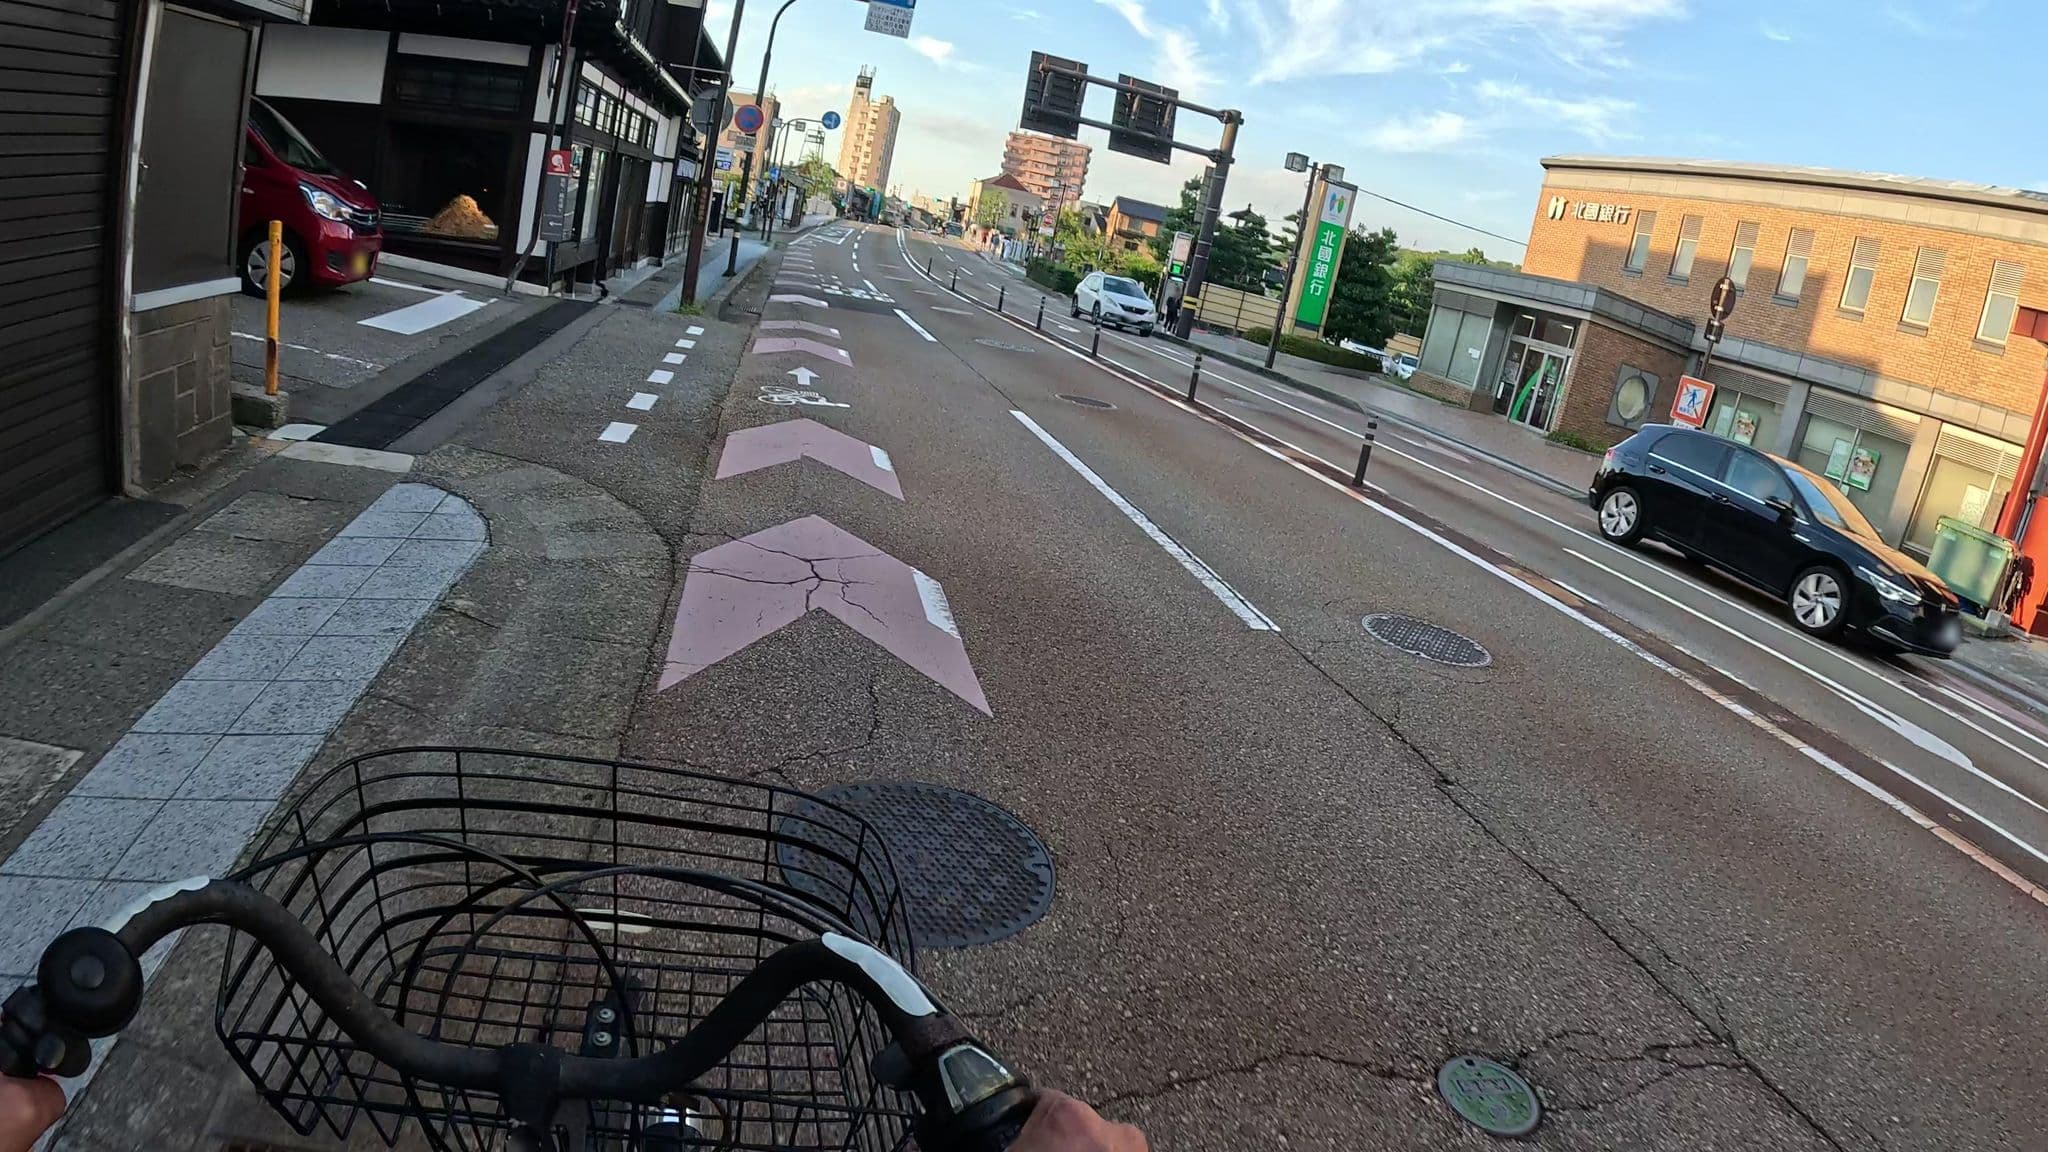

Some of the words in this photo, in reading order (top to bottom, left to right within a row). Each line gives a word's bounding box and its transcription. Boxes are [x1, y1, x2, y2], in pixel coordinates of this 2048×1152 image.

[1570, 200, 1632, 225] 北國銀行
[1309, 229, 1336, 296] 北國銀行
